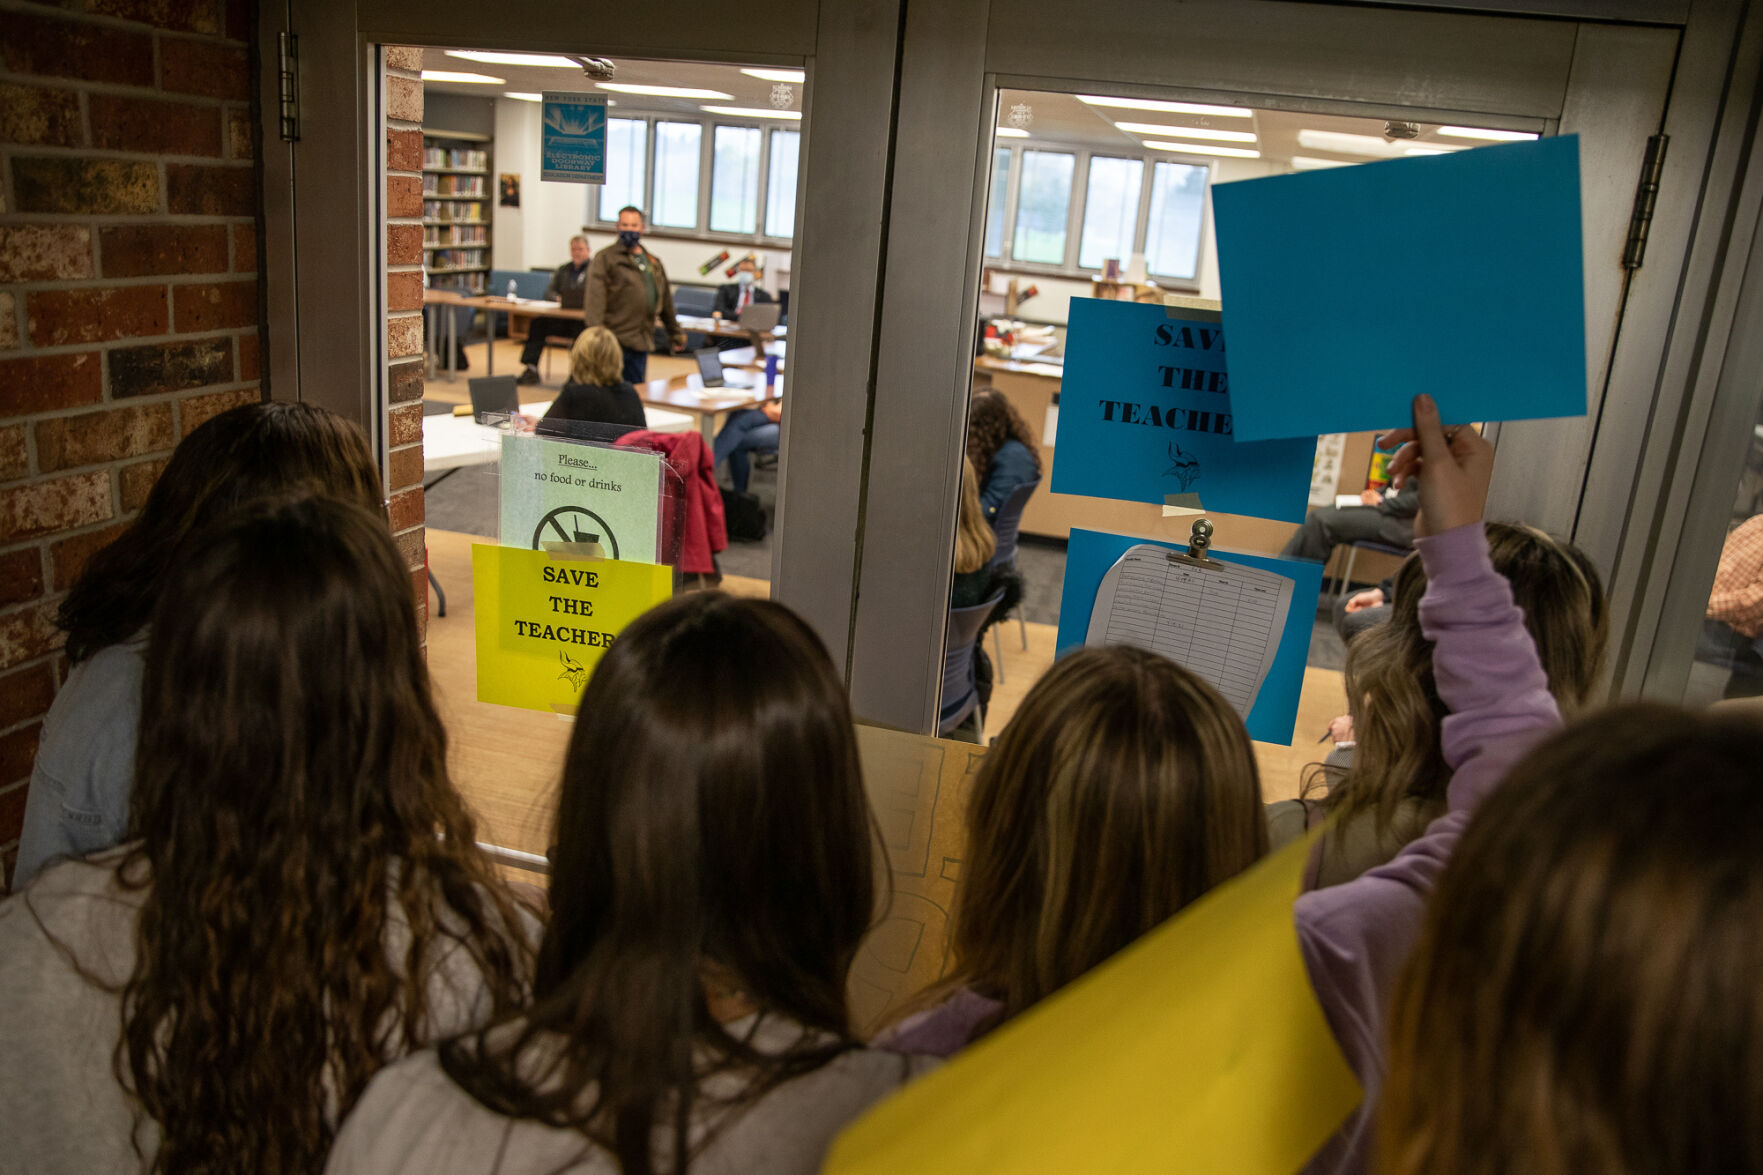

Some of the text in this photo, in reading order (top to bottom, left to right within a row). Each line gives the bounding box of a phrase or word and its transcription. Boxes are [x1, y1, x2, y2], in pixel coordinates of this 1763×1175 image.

[544, 151, 601, 161] ELECTRONIC
[551, 158, 596, 166] DOORWAY
[1154, 323, 1226, 352] SAV
[1158, 365, 1228, 394] THE
[1099, 400, 1233, 435] TEACHE
[534, 472, 622, 493] no food or drinks
[543, 566, 599, 588] SAVE
[549, 596, 593, 617] THE
[514, 620, 615, 649] TEACHER
